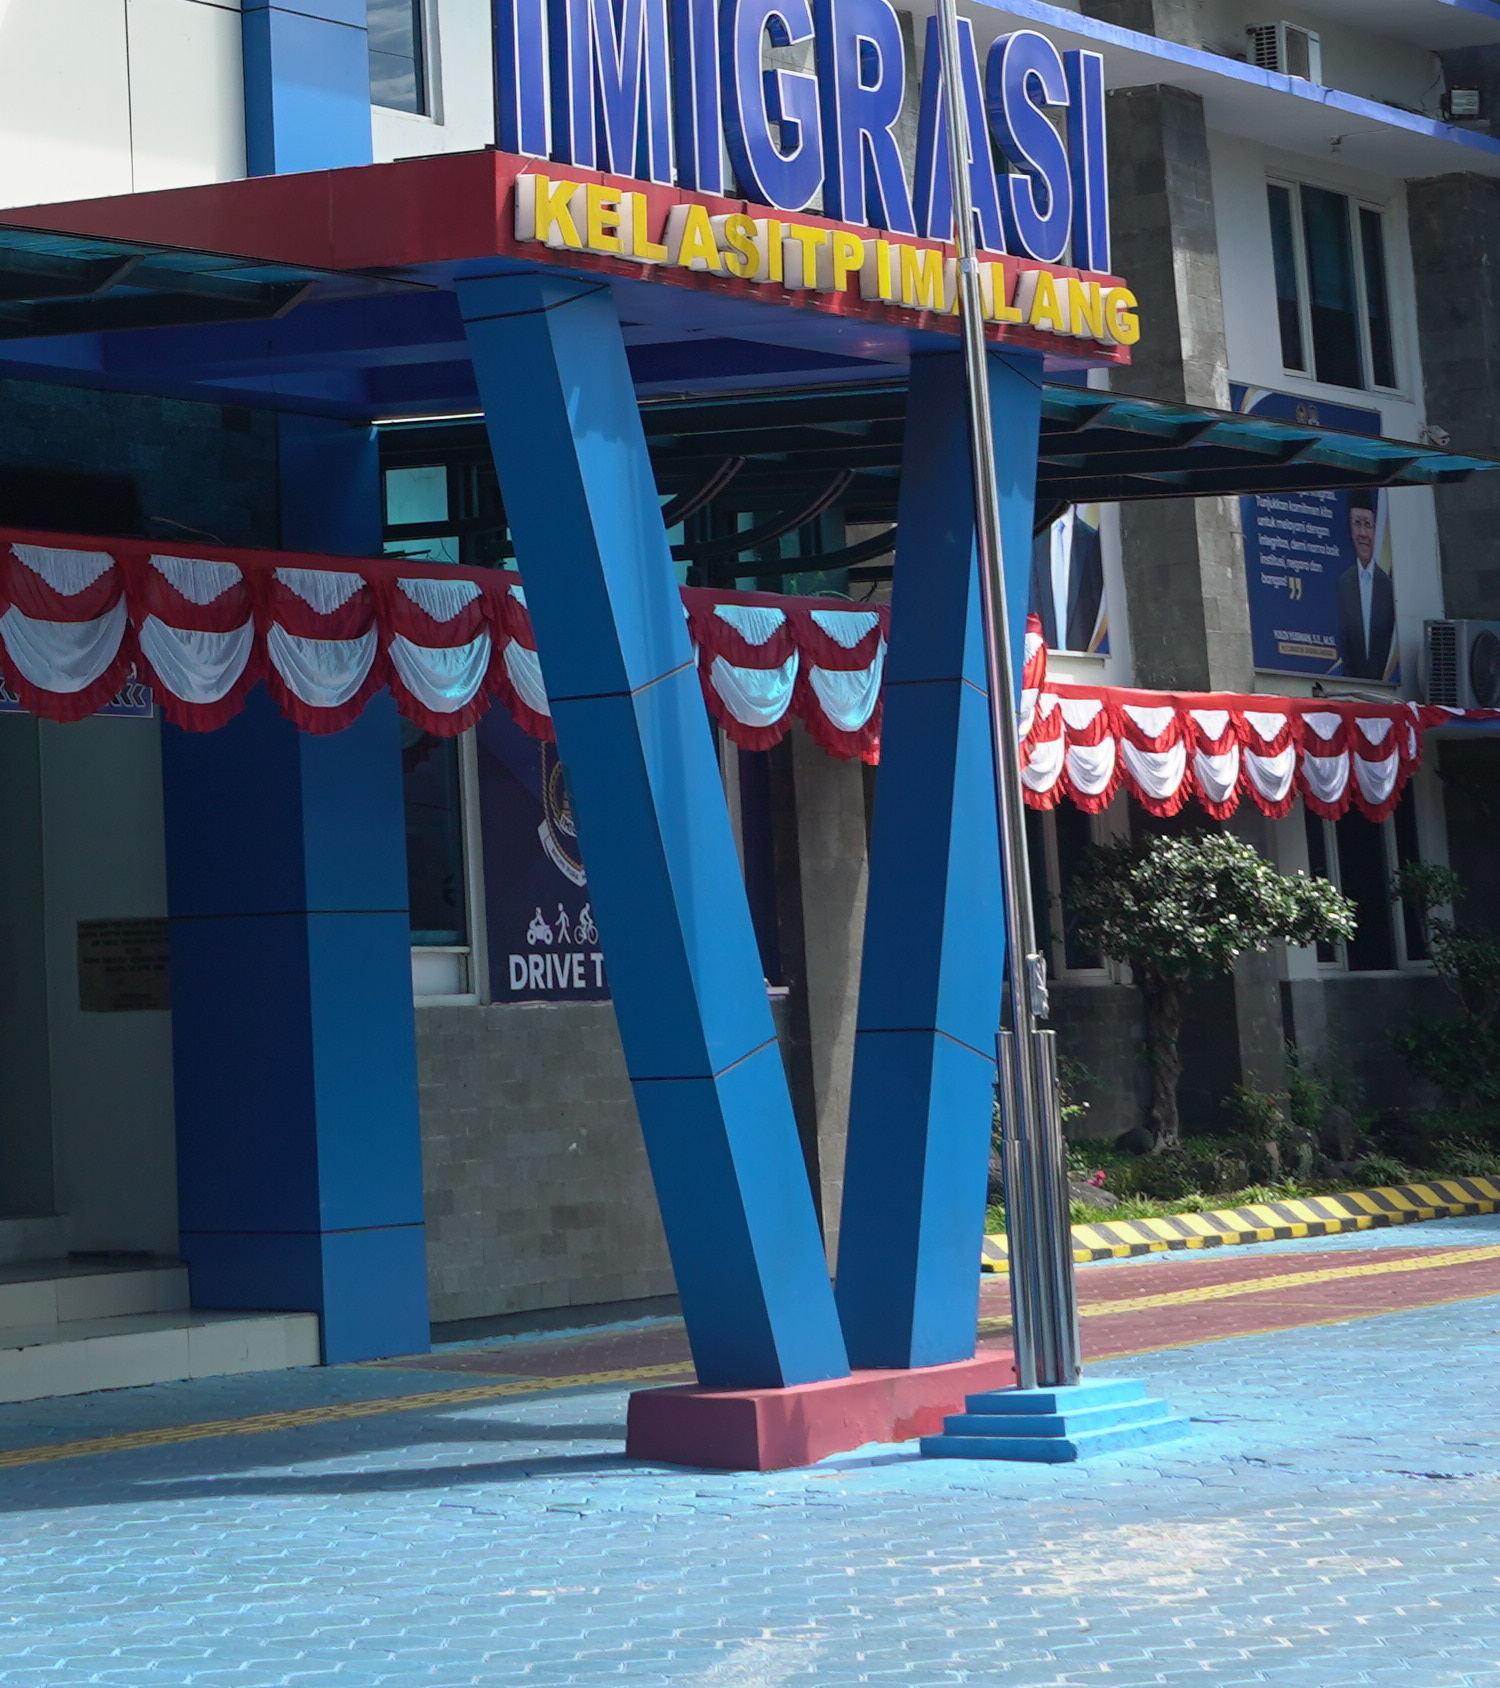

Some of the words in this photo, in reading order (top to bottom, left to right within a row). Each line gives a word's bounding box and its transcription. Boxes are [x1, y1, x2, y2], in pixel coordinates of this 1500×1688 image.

[517, 173, 760, 281] KELAS
[1257, 516, 1276, 528] untuk
[1276, 518, 1306, 534] melayani
[1306, 522, 1330, 539] dengan
[1291, 539, 1307, 551] demi
[1307, 543, 1326, 554] nama
[1325, 544, 1340, 557] baik
[1287, 558, 1310, 573] negara
[1310, 560, 1323, 573] dan
[509, 953, 586, 990] DRIVE
